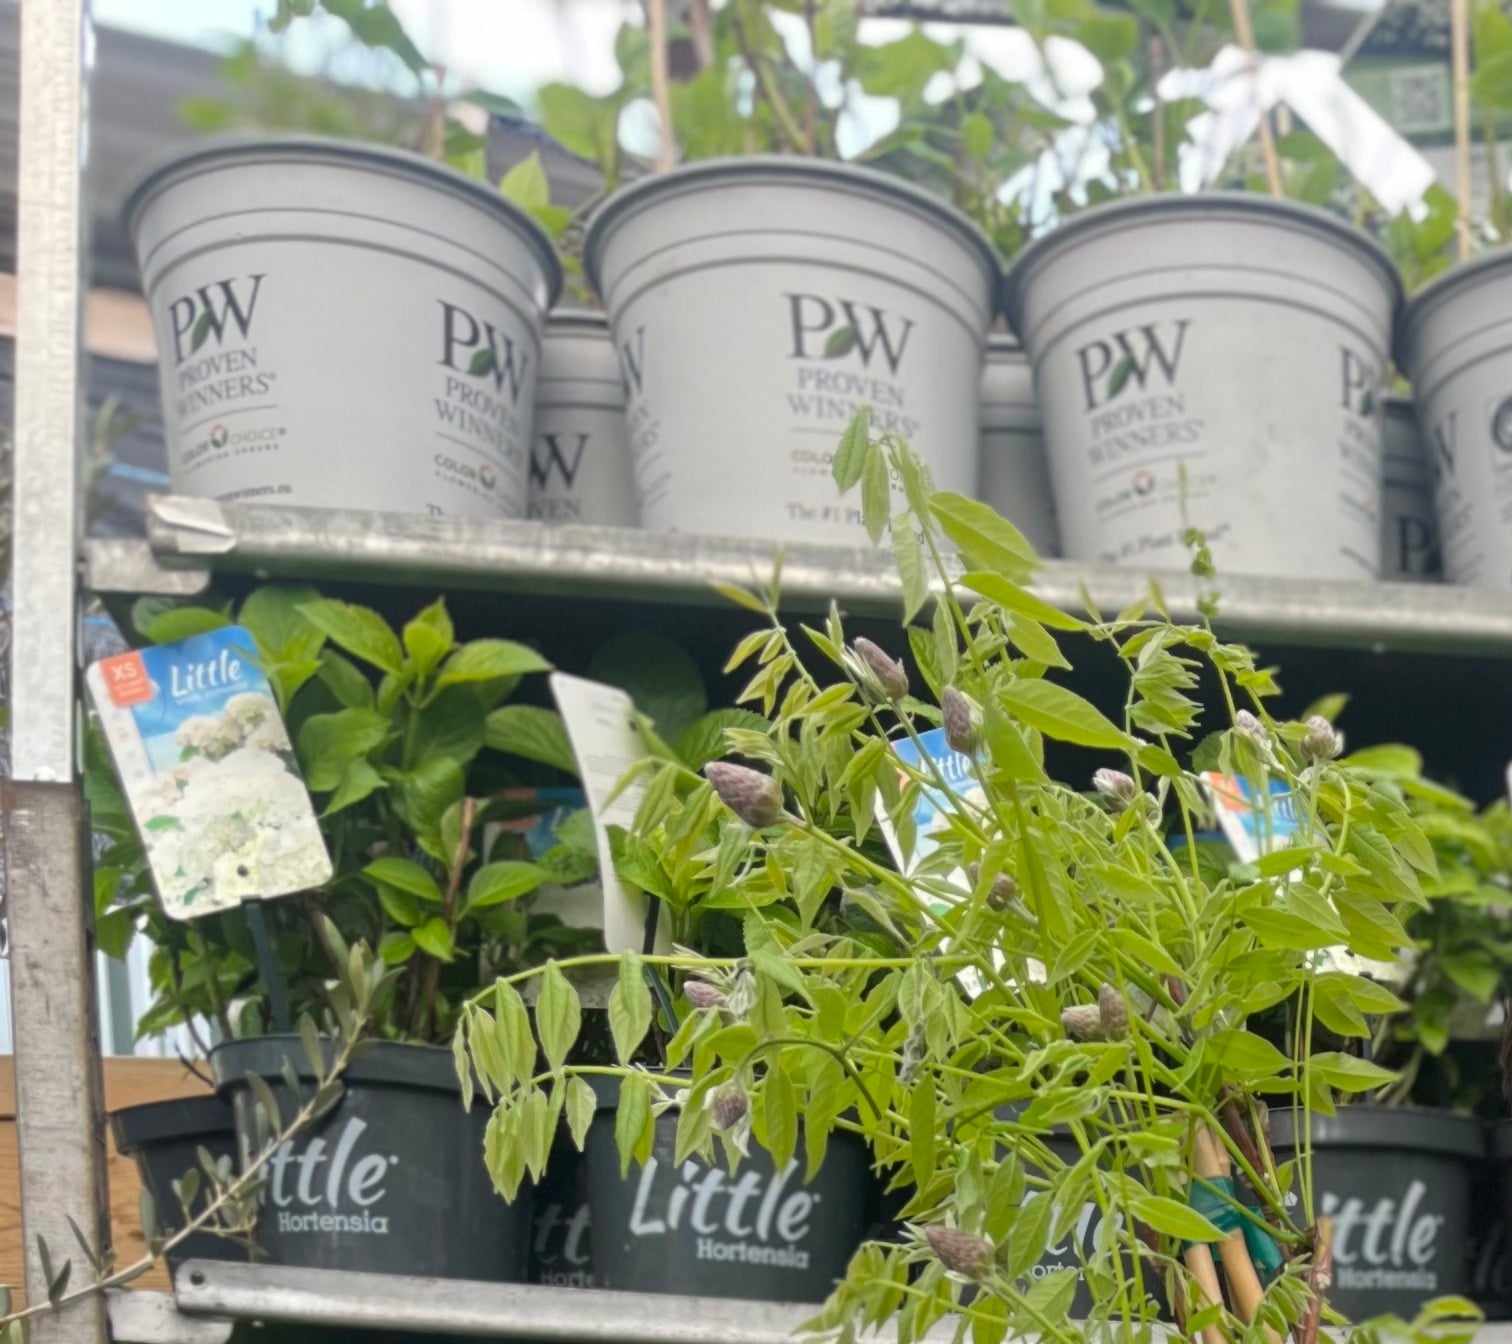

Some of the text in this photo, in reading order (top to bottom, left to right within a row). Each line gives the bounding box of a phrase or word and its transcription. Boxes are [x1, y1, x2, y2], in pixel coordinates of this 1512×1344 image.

[168, 273, 267, 366] PW
[783, 292, 915, 377] PW
[797, 366, 905, 408] PROVEN
[1075, 318, 1193, 415] PW
[170, 648, 242, 698] Little
[277, 1210, 390, 1235] Hortensia
[628, 1155, 814, 1243] Little
[695, 1238, 812, 1270] Hortensia
